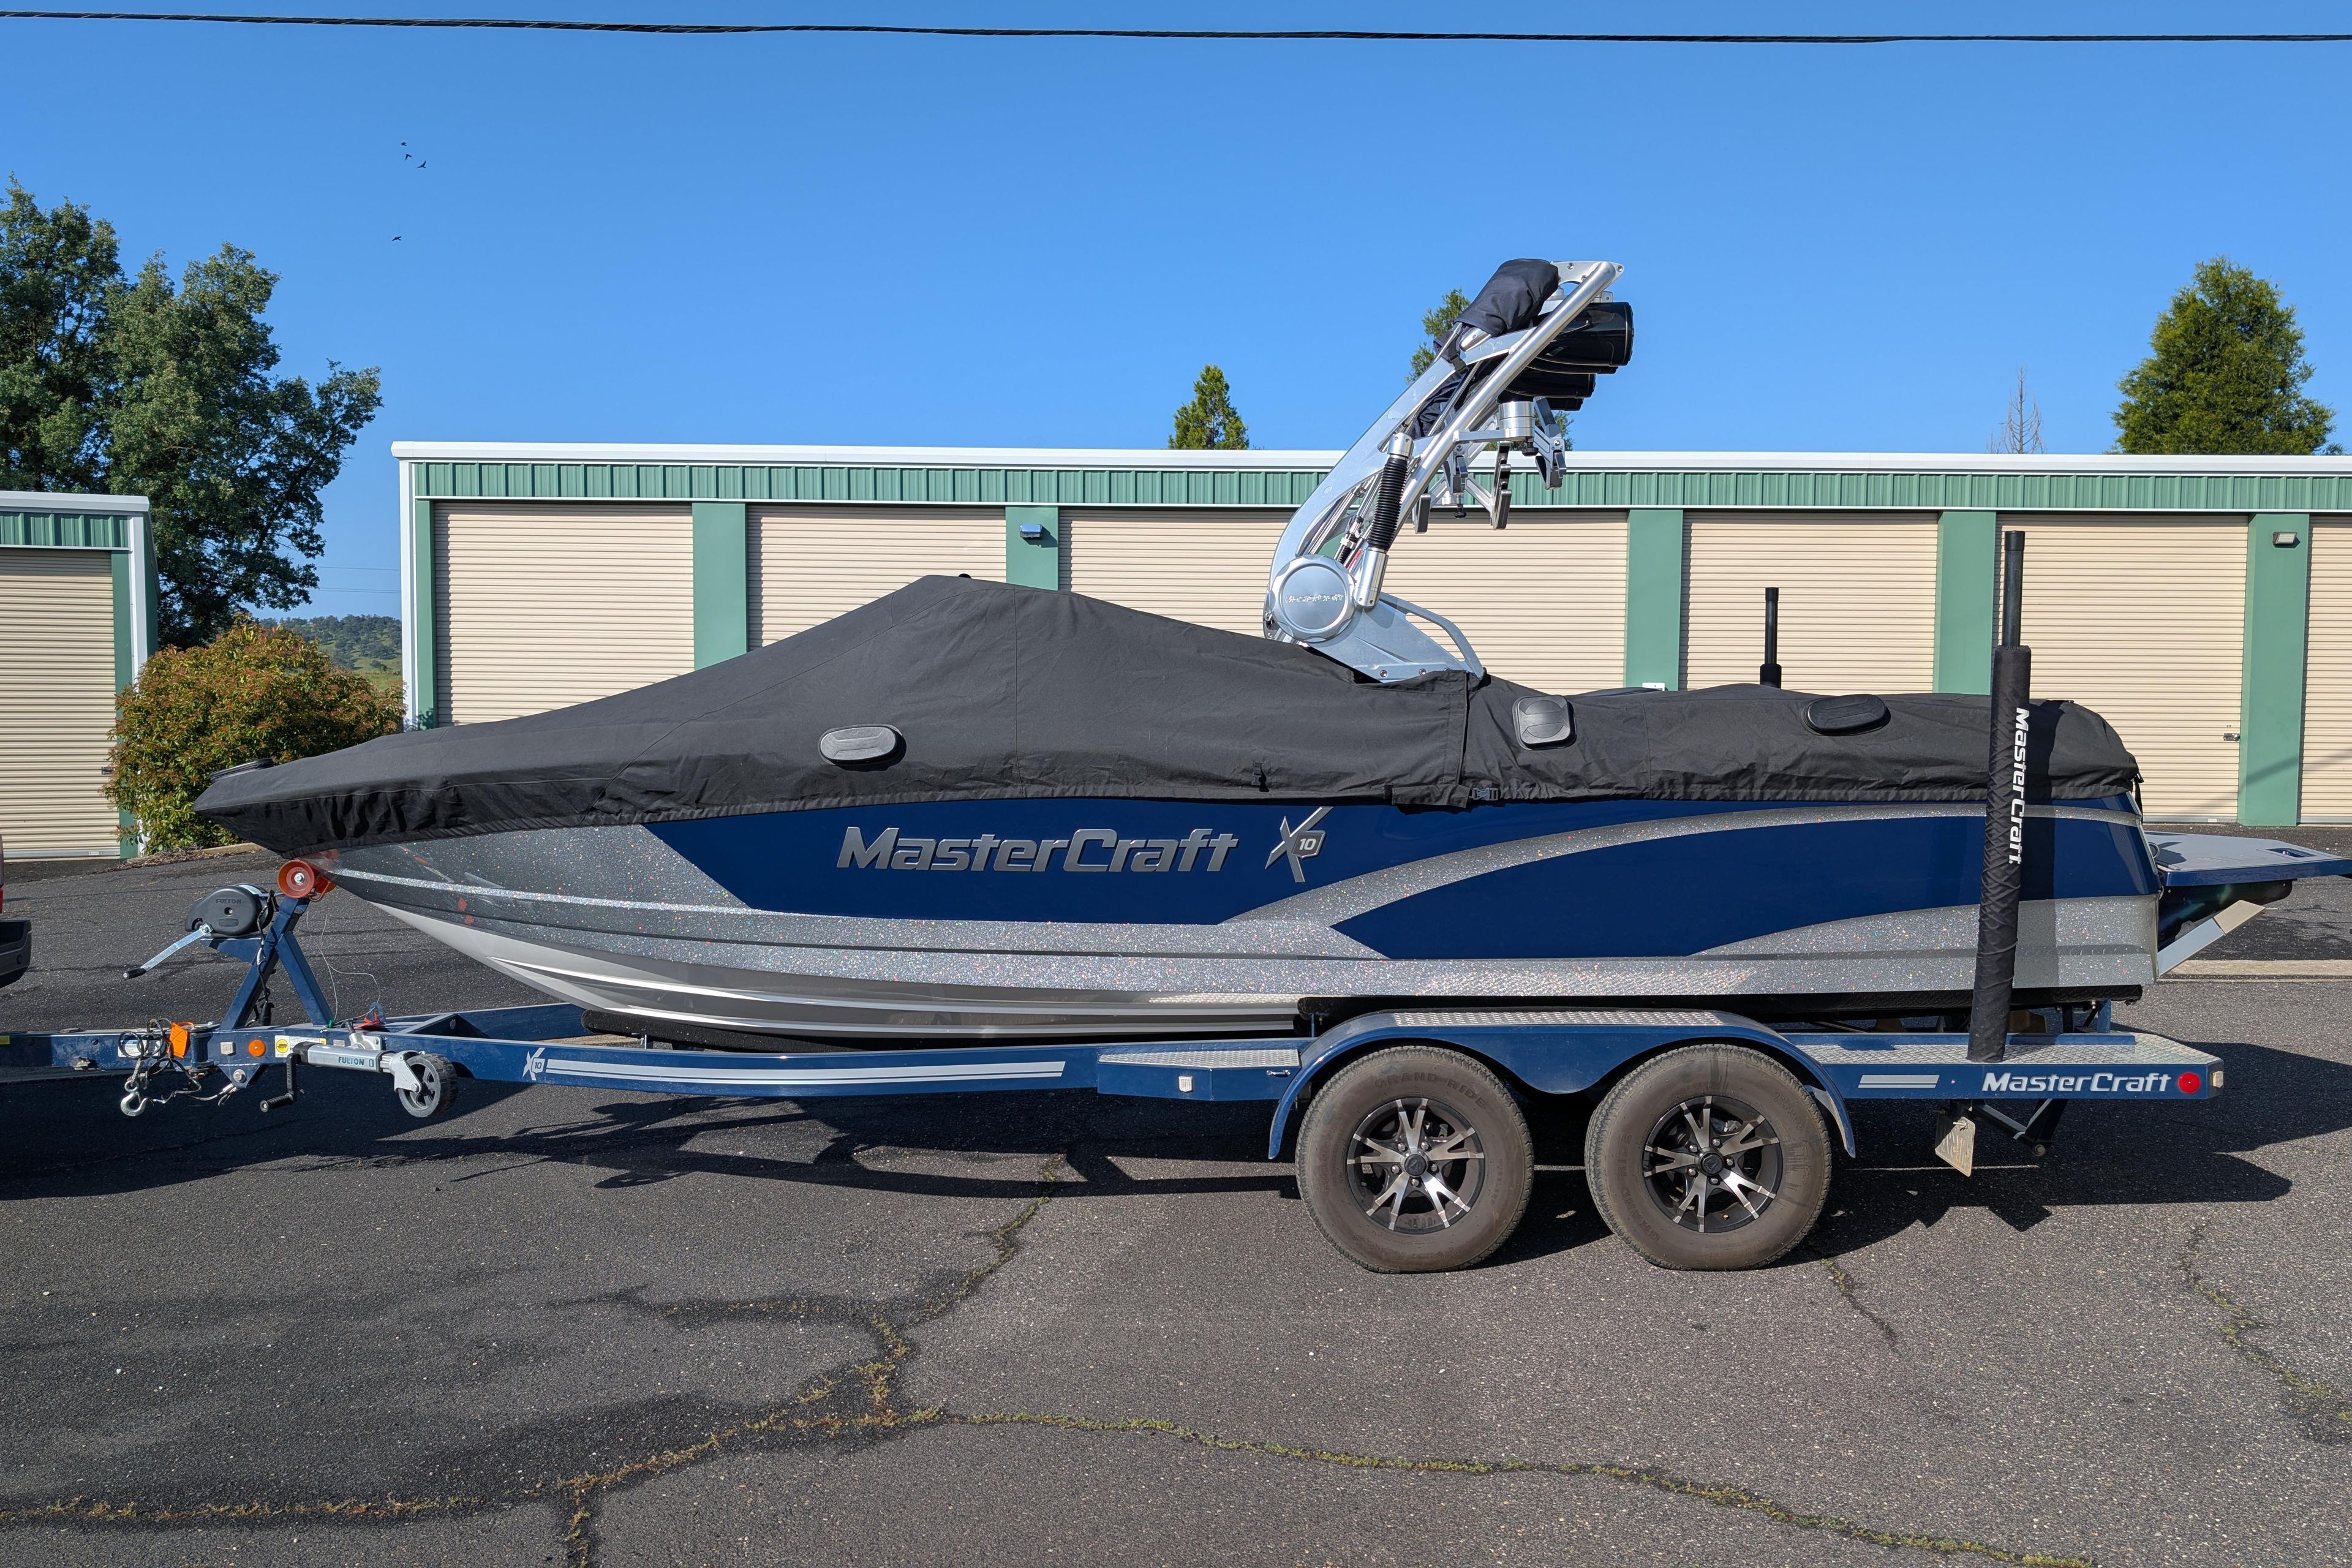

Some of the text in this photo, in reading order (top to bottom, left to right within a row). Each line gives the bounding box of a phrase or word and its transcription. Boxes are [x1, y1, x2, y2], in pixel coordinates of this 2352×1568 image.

[2008, 707, 2030, 864] MasterCraft
[836, 827, 1239, 872] MasterCraft
[1298, 837, 1316, 851] 10
[338, 1056, 364, 1066] FULTON
[1373, 1072, 1487, 1109] GRAND RIDE
[1981, 1072, 2171, 1092] MasterCraft
